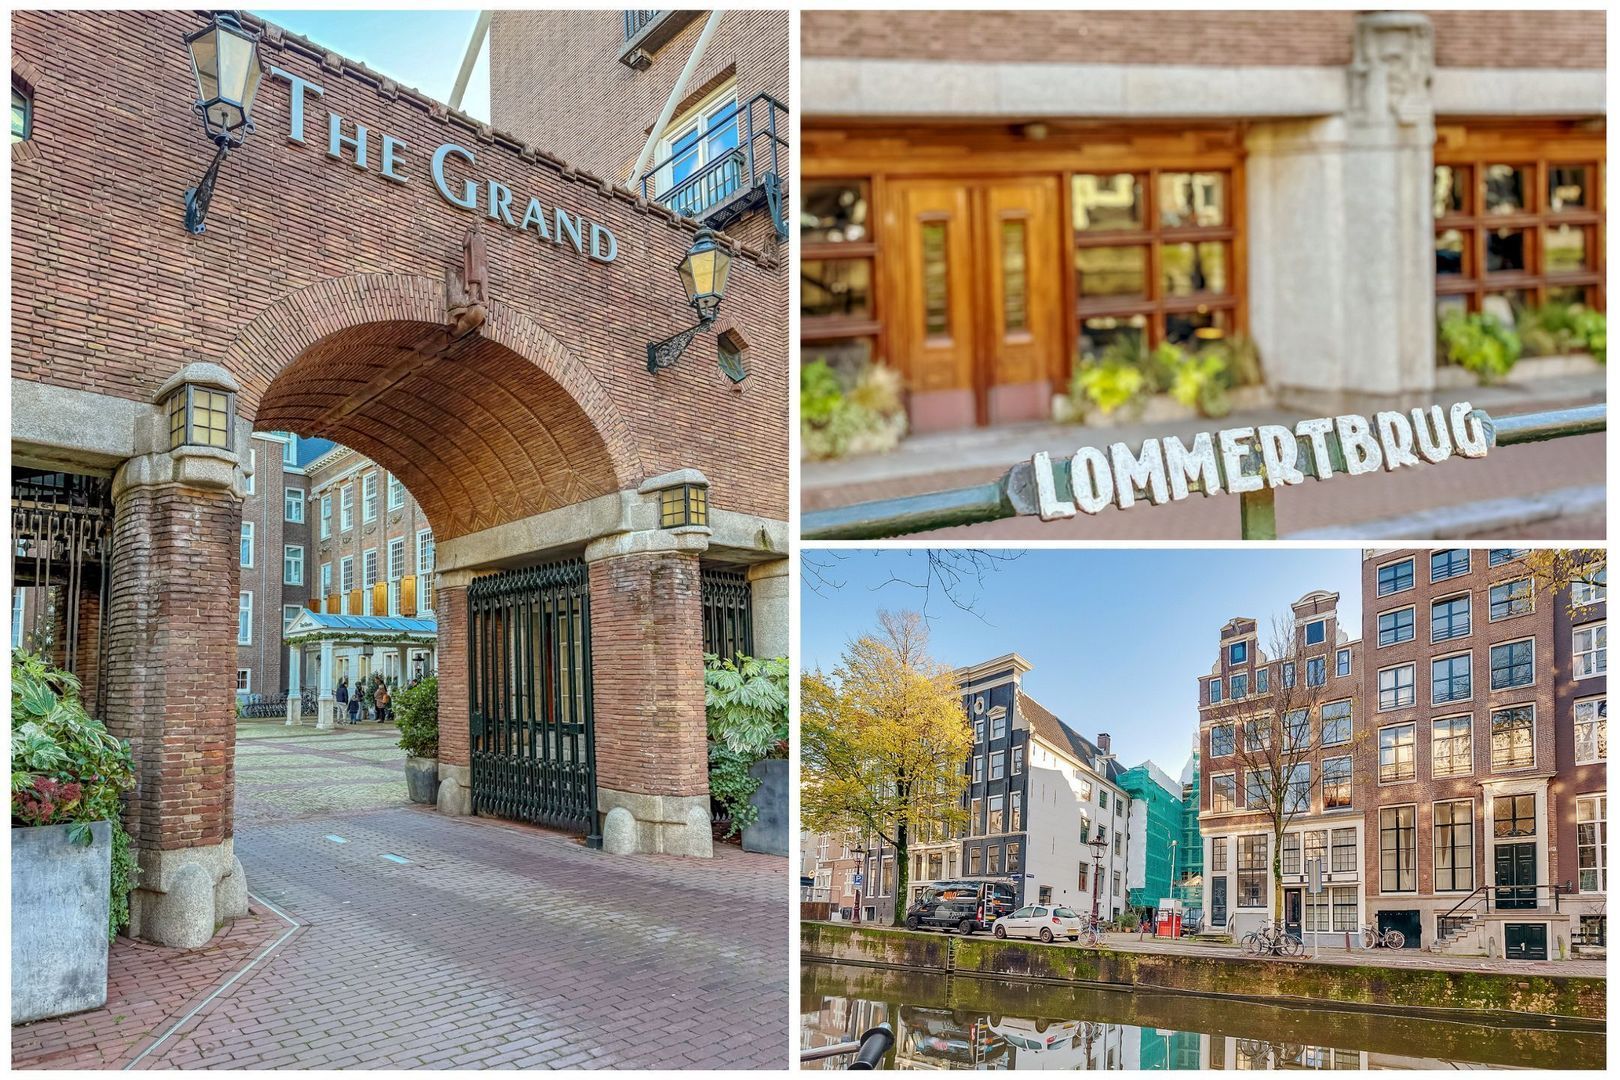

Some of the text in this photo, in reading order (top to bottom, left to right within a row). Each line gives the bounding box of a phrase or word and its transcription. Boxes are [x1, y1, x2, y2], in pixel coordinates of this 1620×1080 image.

[270, 65, 618, 264] THE GRAND
[1032, 401, 1488, 522] LOMMERTBRUG
